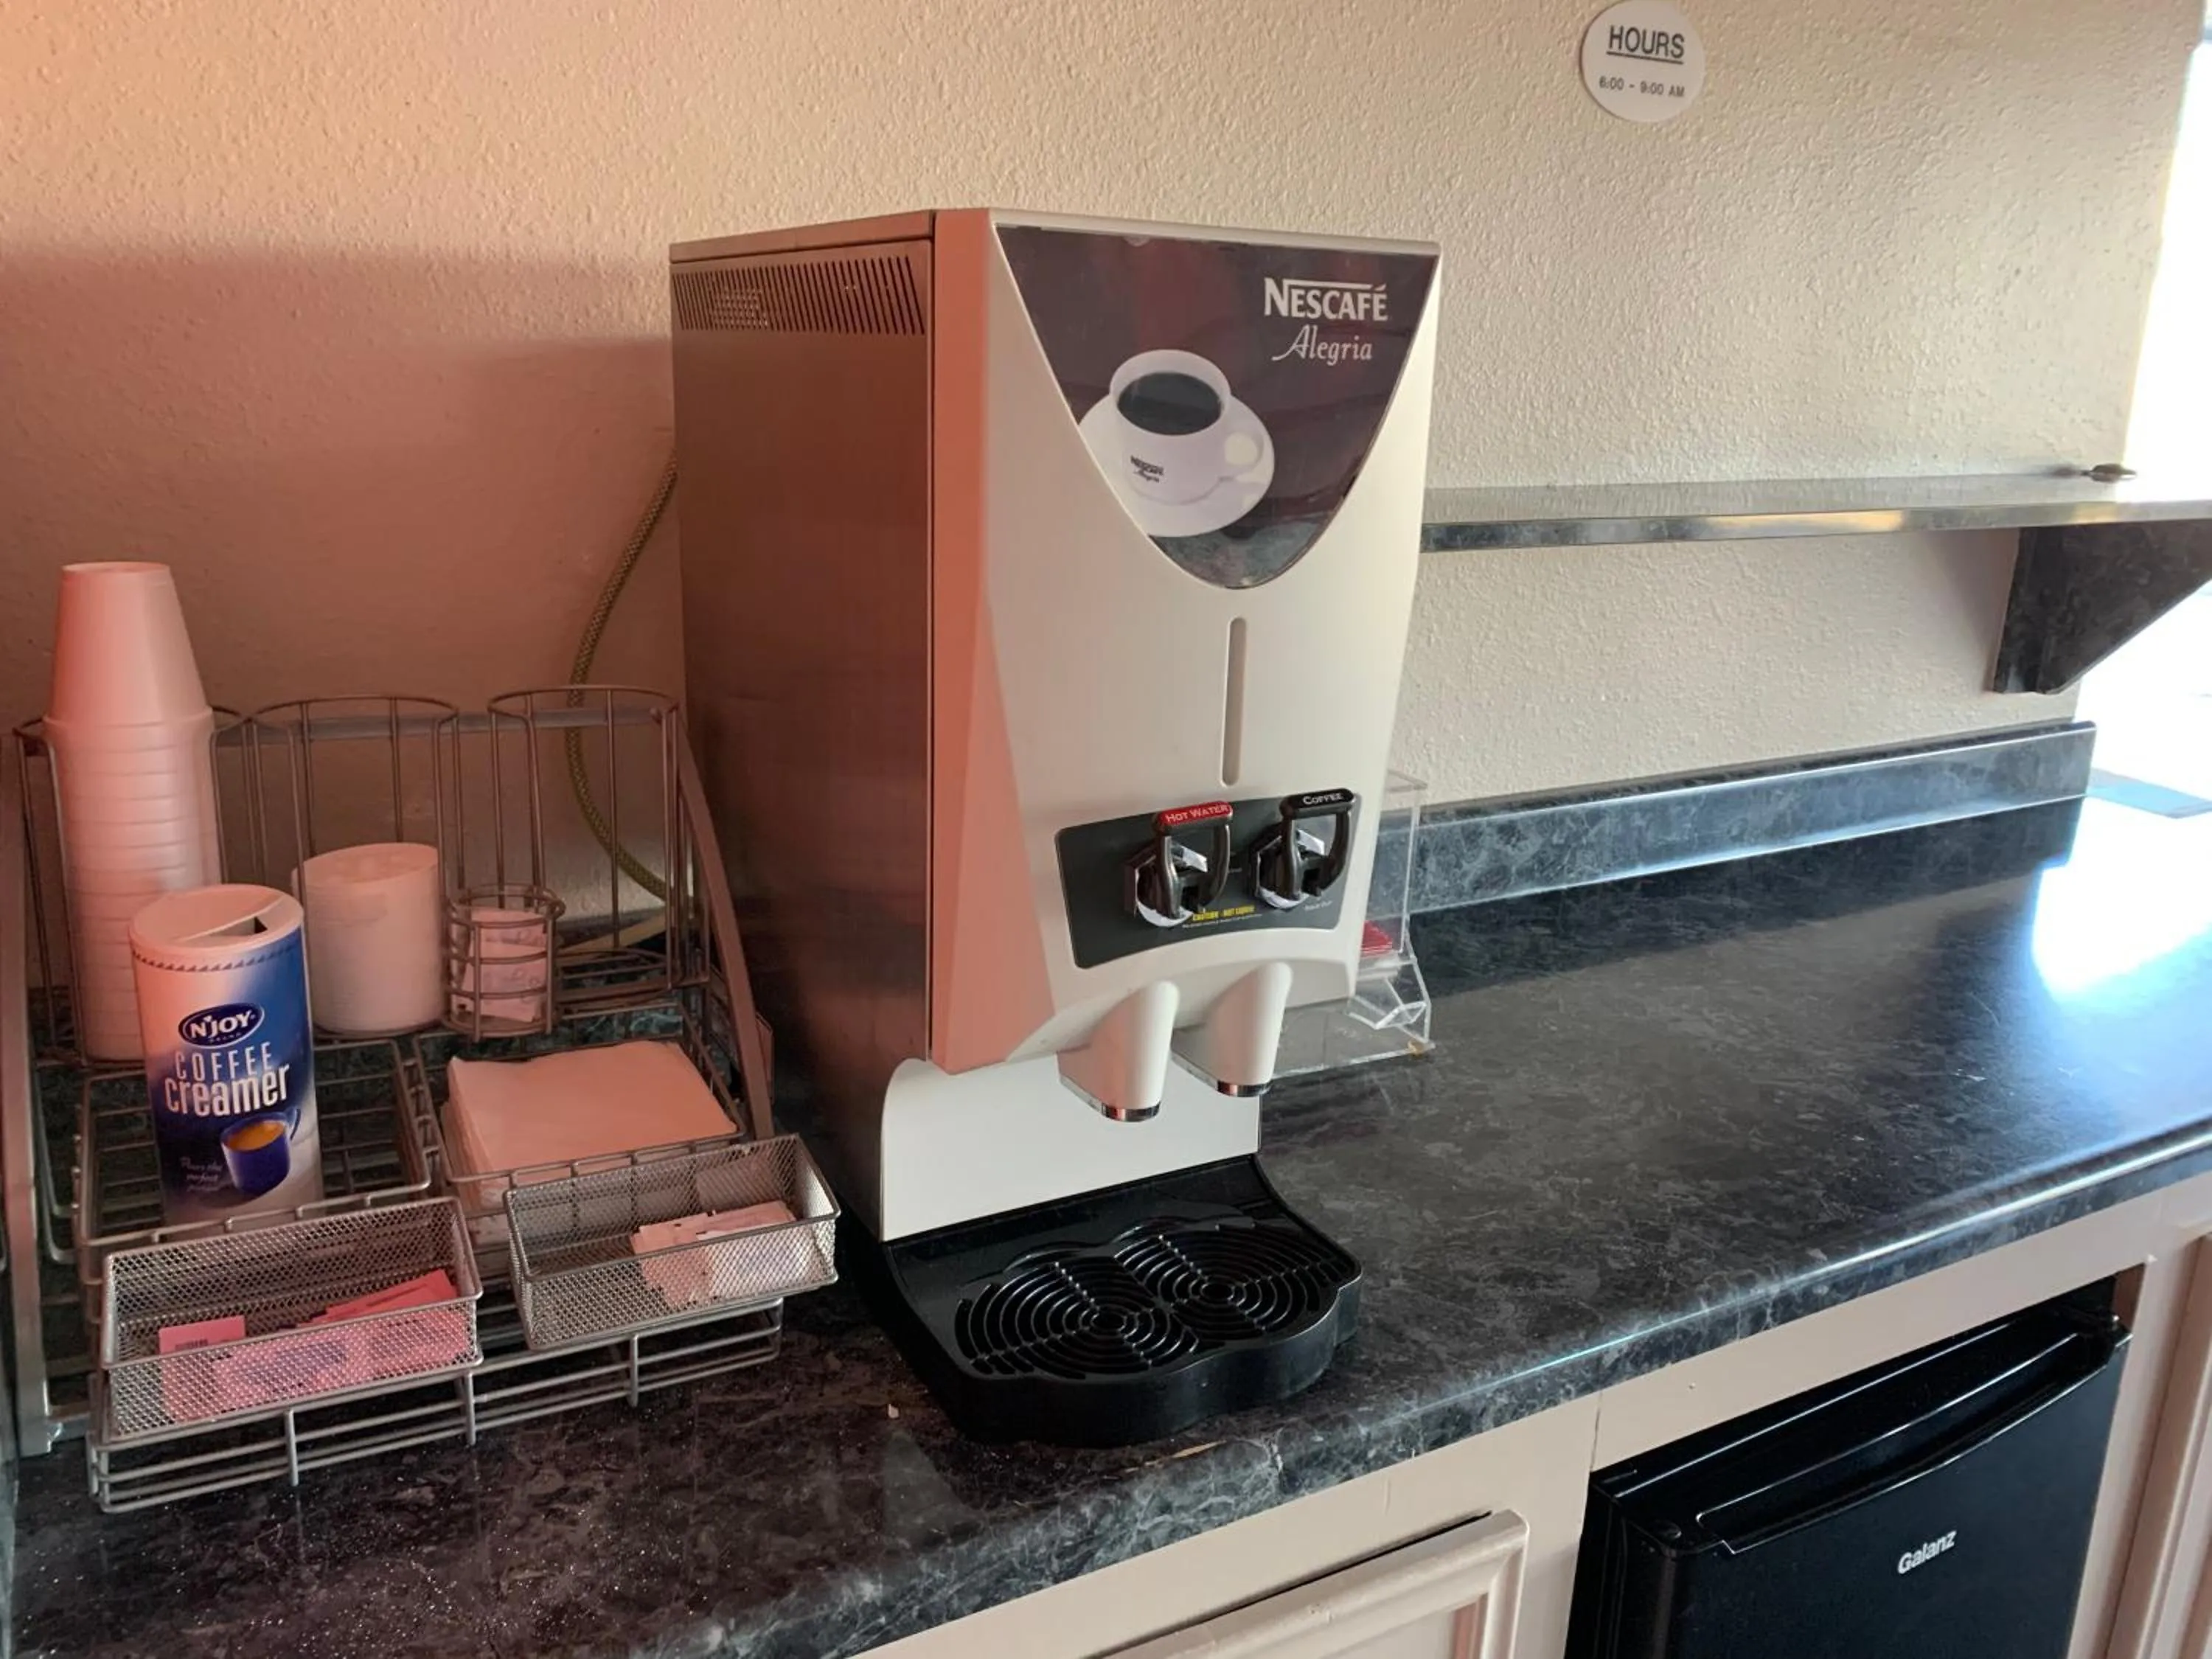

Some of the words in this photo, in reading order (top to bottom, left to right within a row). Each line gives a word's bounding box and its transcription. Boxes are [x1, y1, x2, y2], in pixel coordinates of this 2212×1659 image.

[1608, 25, 1685, 58] HOURS
[1599, 76, 1624, 90] 6:00
[1640, 80, 1664, 95] 9:00
[1669, 86, 1686, 97] AM
[1264, 277, 1388, 321] NESCAFÉ
[1270, 324, 1372, 366] Alegria
[1165, 812, 1188, 823] HOT
[1189, 804, 1229, 818] WATER
[175, 1041, 272, 1081] COFFEE
[164, 1063, 290, 1117] creamer
[1897, 1530, 1957, 1574] Galanz
